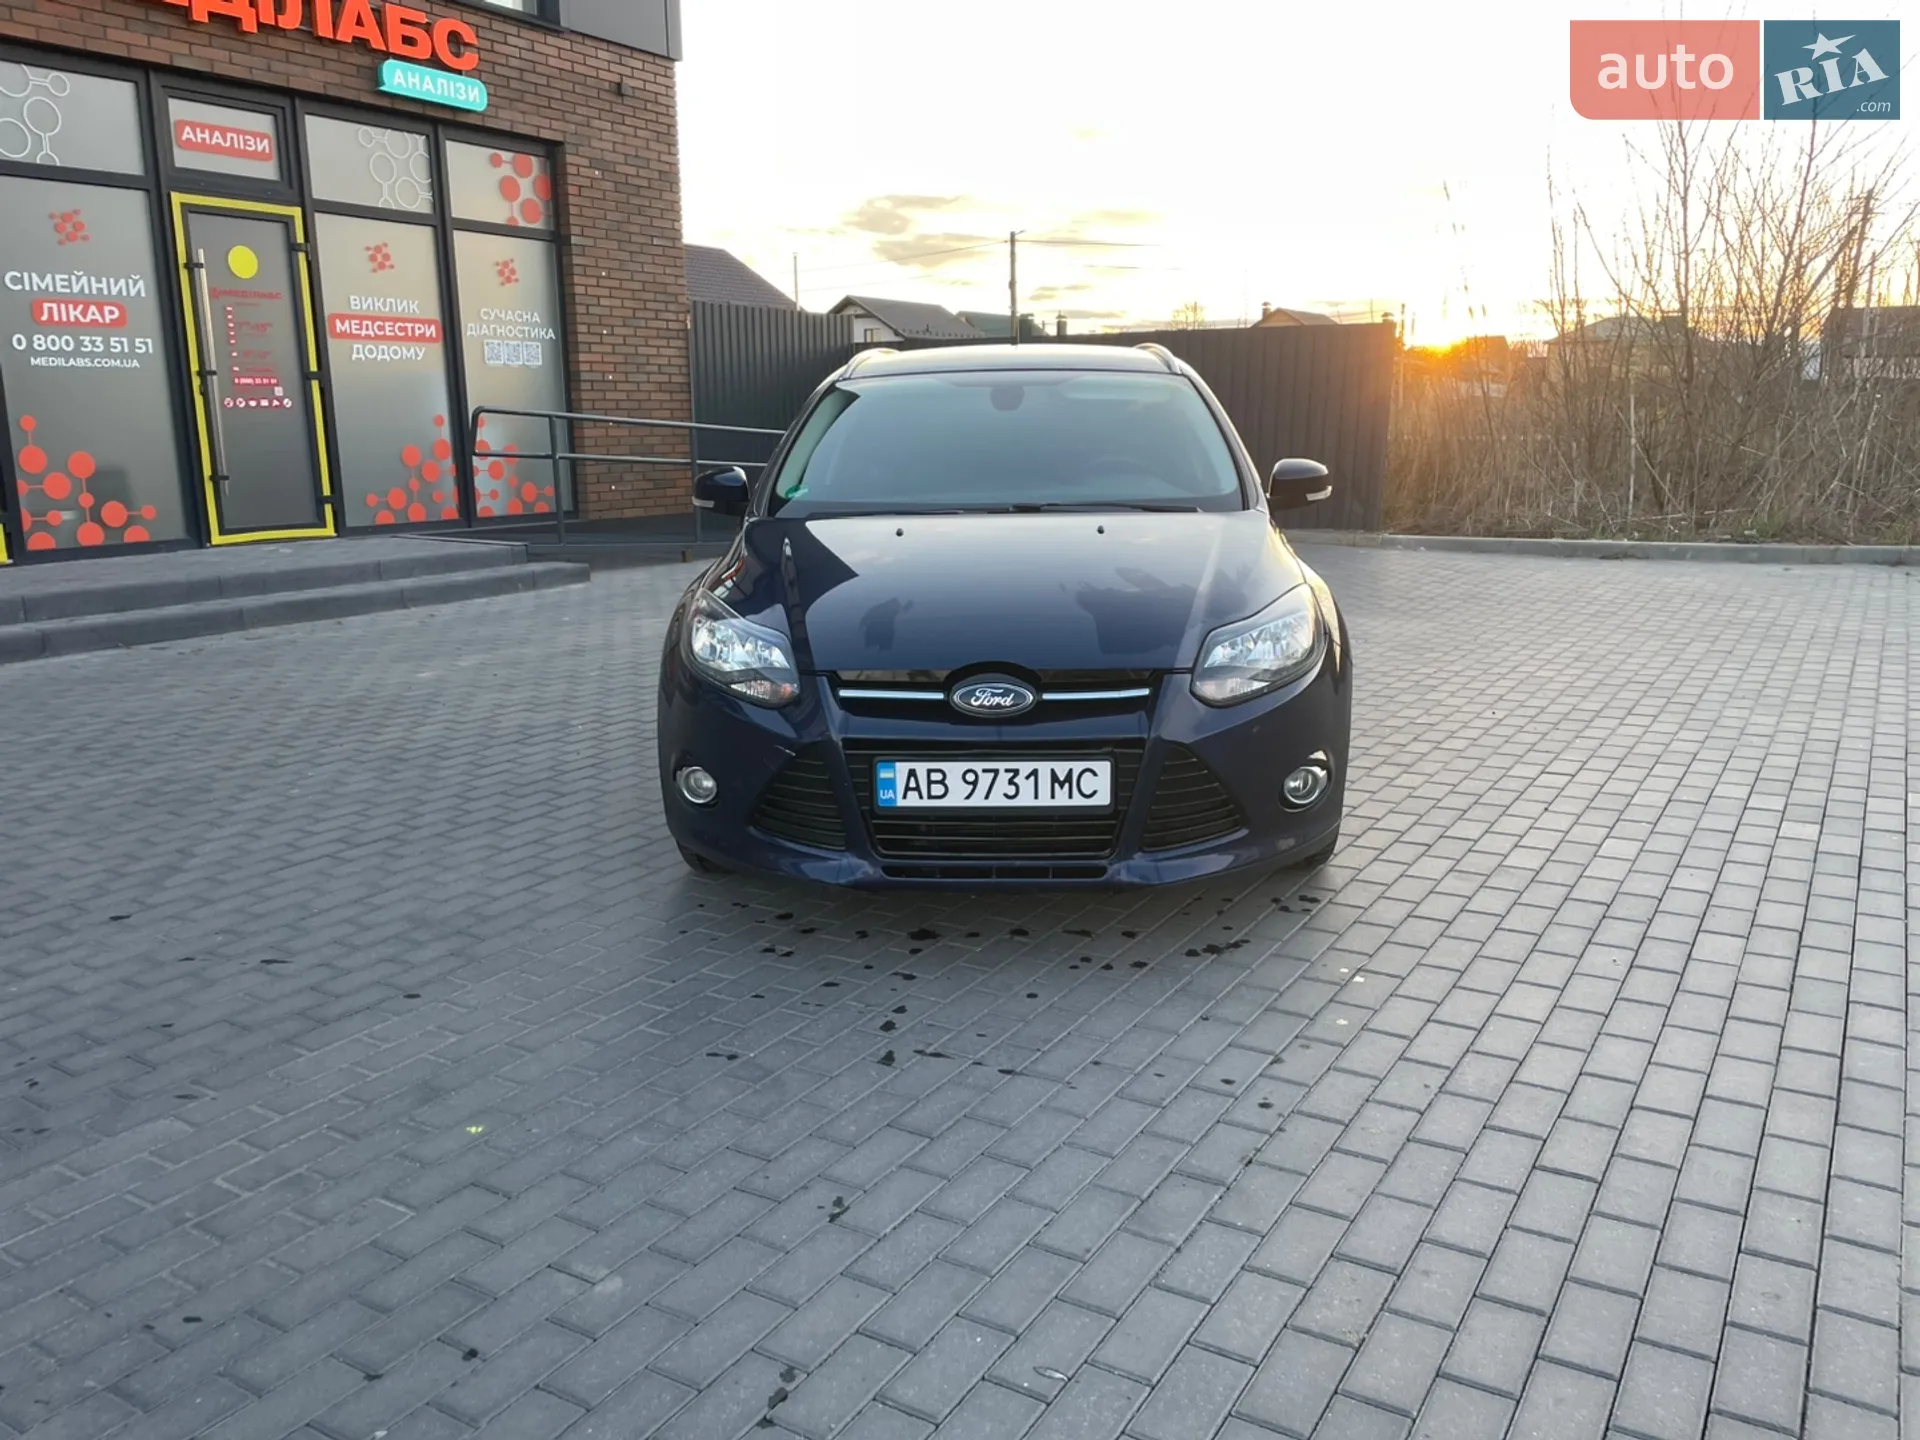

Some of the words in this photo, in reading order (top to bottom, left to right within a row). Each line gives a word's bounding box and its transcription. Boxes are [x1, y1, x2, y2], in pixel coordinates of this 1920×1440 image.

[393, 69, 481, 104] АНАЛІЗИ
[181, 125, 271, 154] АНАЛІЗИ
[4, 270, 146, 297] СІМЕЙНИЙ
[41, 302, 120, 324] ЛІКАР
[349, 295, 420, 314] ВИКЛИК
[480, 307, 541, 324] СУЧАСНА
[335, 318, 437, 338] МЕДСЕСТРИ
[466, 322, 556, 340] ДІАГНОСТИКА
[12, 333, 27, 350] 0
[32, 334, 75, 351] 800
[79, 335, 104, 352] 33
[109, 337, 129, 353] 51
[134, 338, 153, 354] 51
[351, 343, 426, 362] ДОДОМУ
[30, 356, 141, 368] MEDILABS.COM.UA
[970, 687, 1015, 708] Ford
[901, 768, 950, 800] AB
[961, 768, 1039, 800] 9731
[1050, 767, 1099, 800] MC
[879, 789, 895, 799] UA
